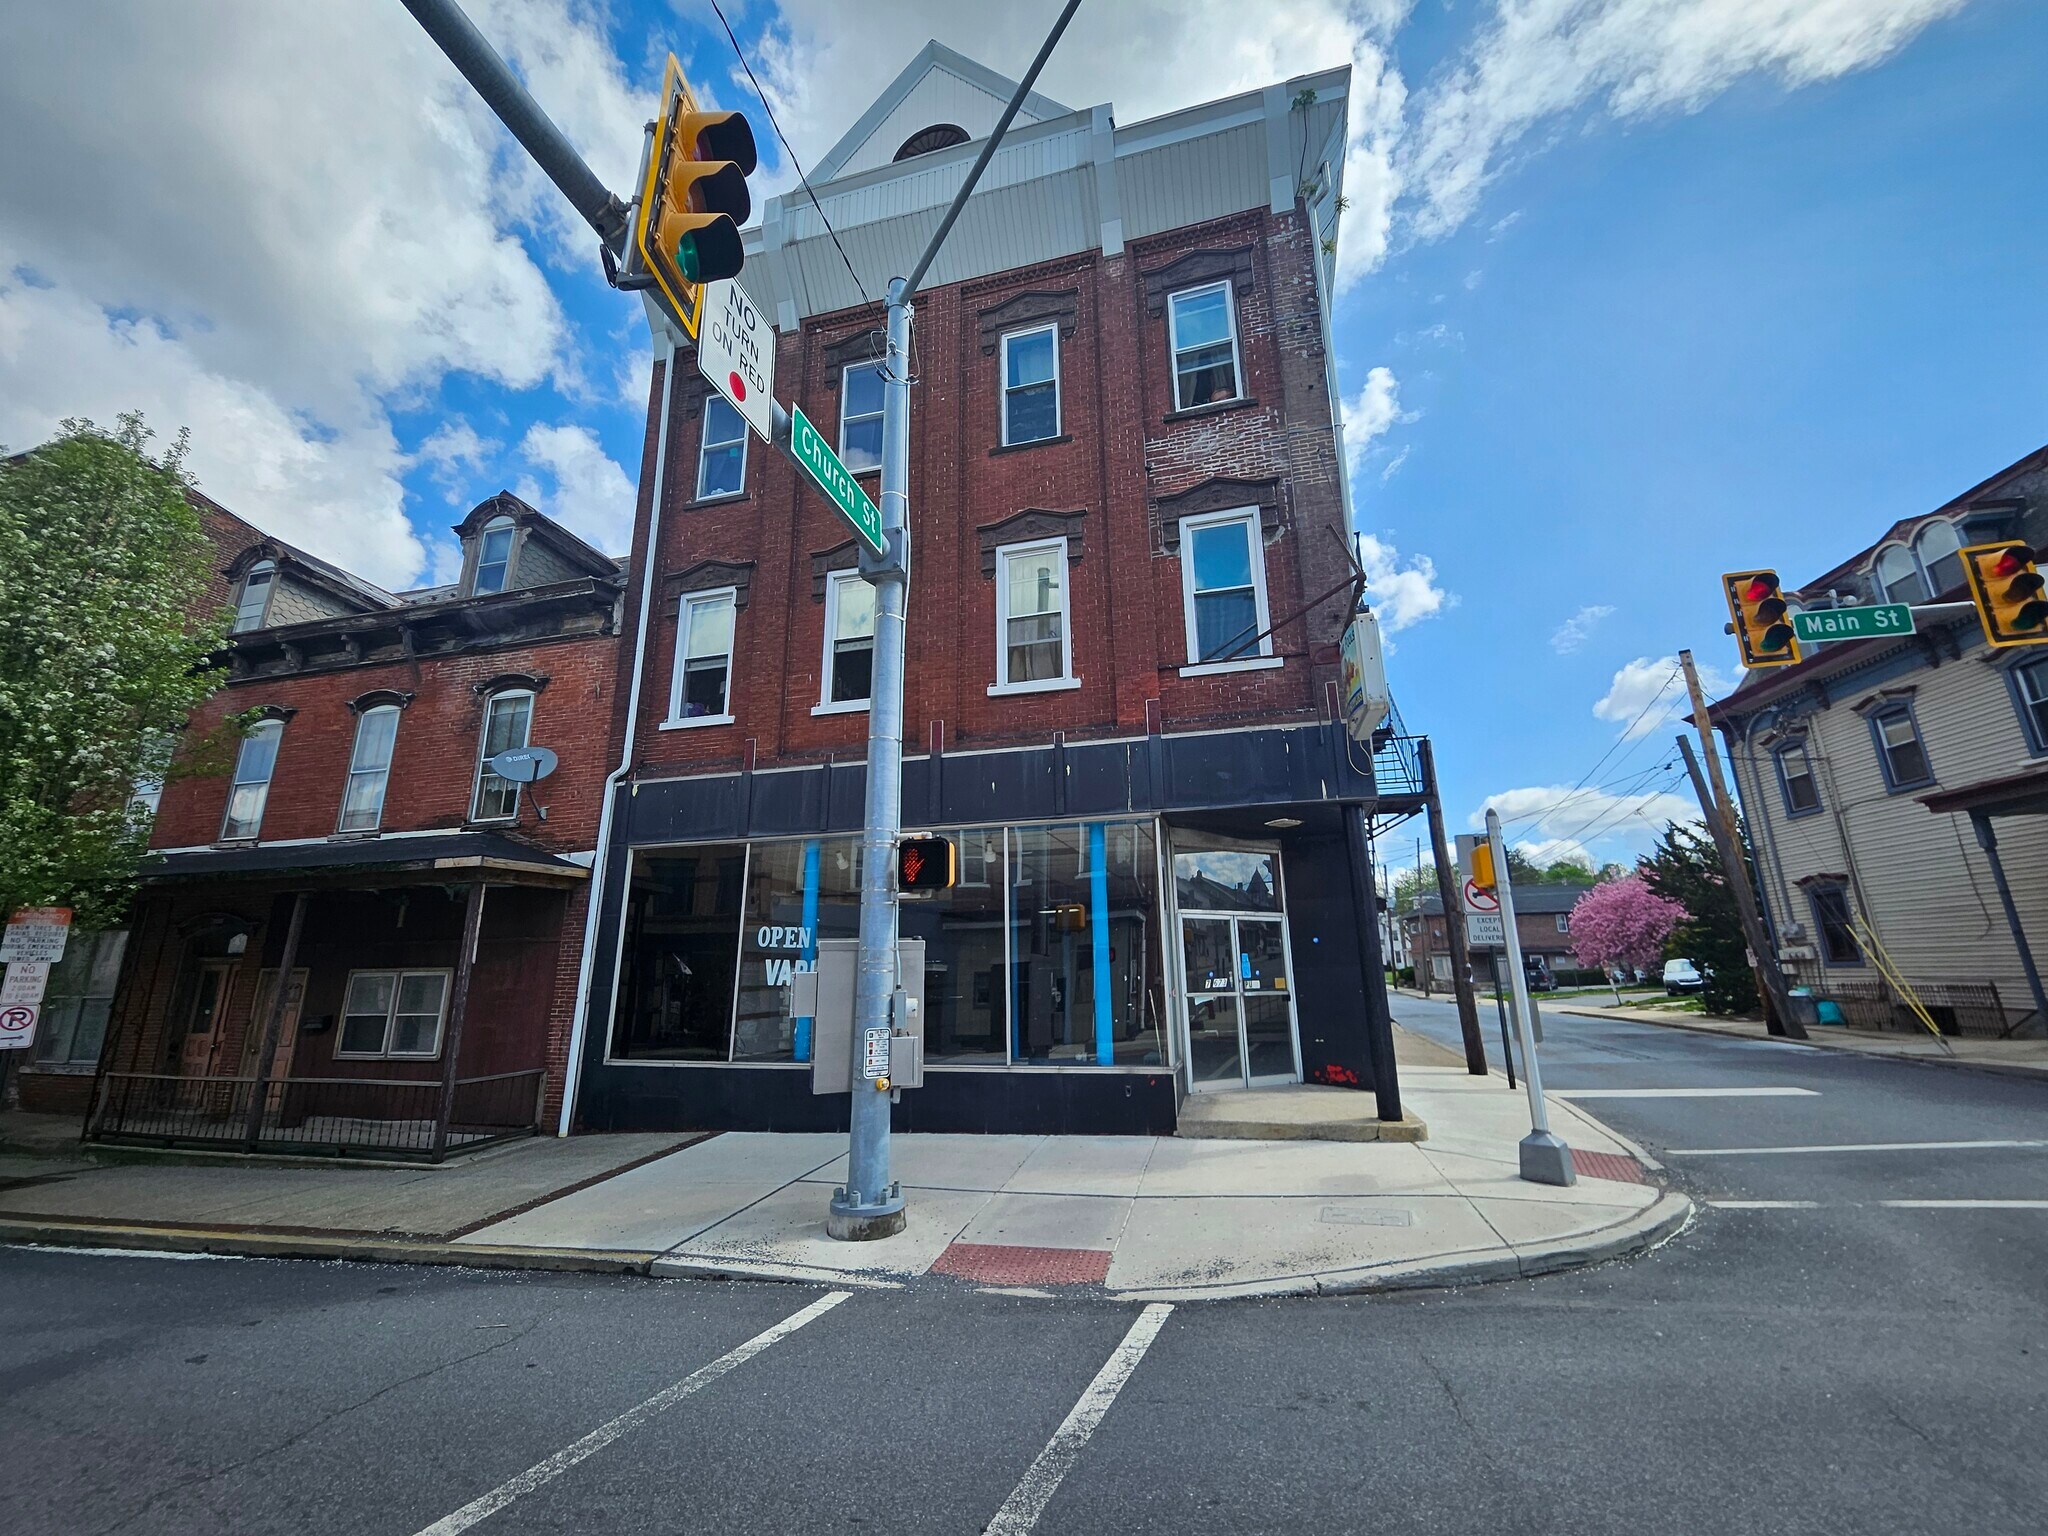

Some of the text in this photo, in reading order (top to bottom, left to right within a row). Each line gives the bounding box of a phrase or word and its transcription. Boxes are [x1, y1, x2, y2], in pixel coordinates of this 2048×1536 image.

[729, 284, 755, 331] NO
[712, 321, 765, 394] ON RED
[724, 305, 759, 364] TURN
[802, 426, 876, 534] Church St
[1805, 609, 1900, 633] Main St
[757, 925, 811, 948] OPEN
[20, 965, 36, 974] NO
